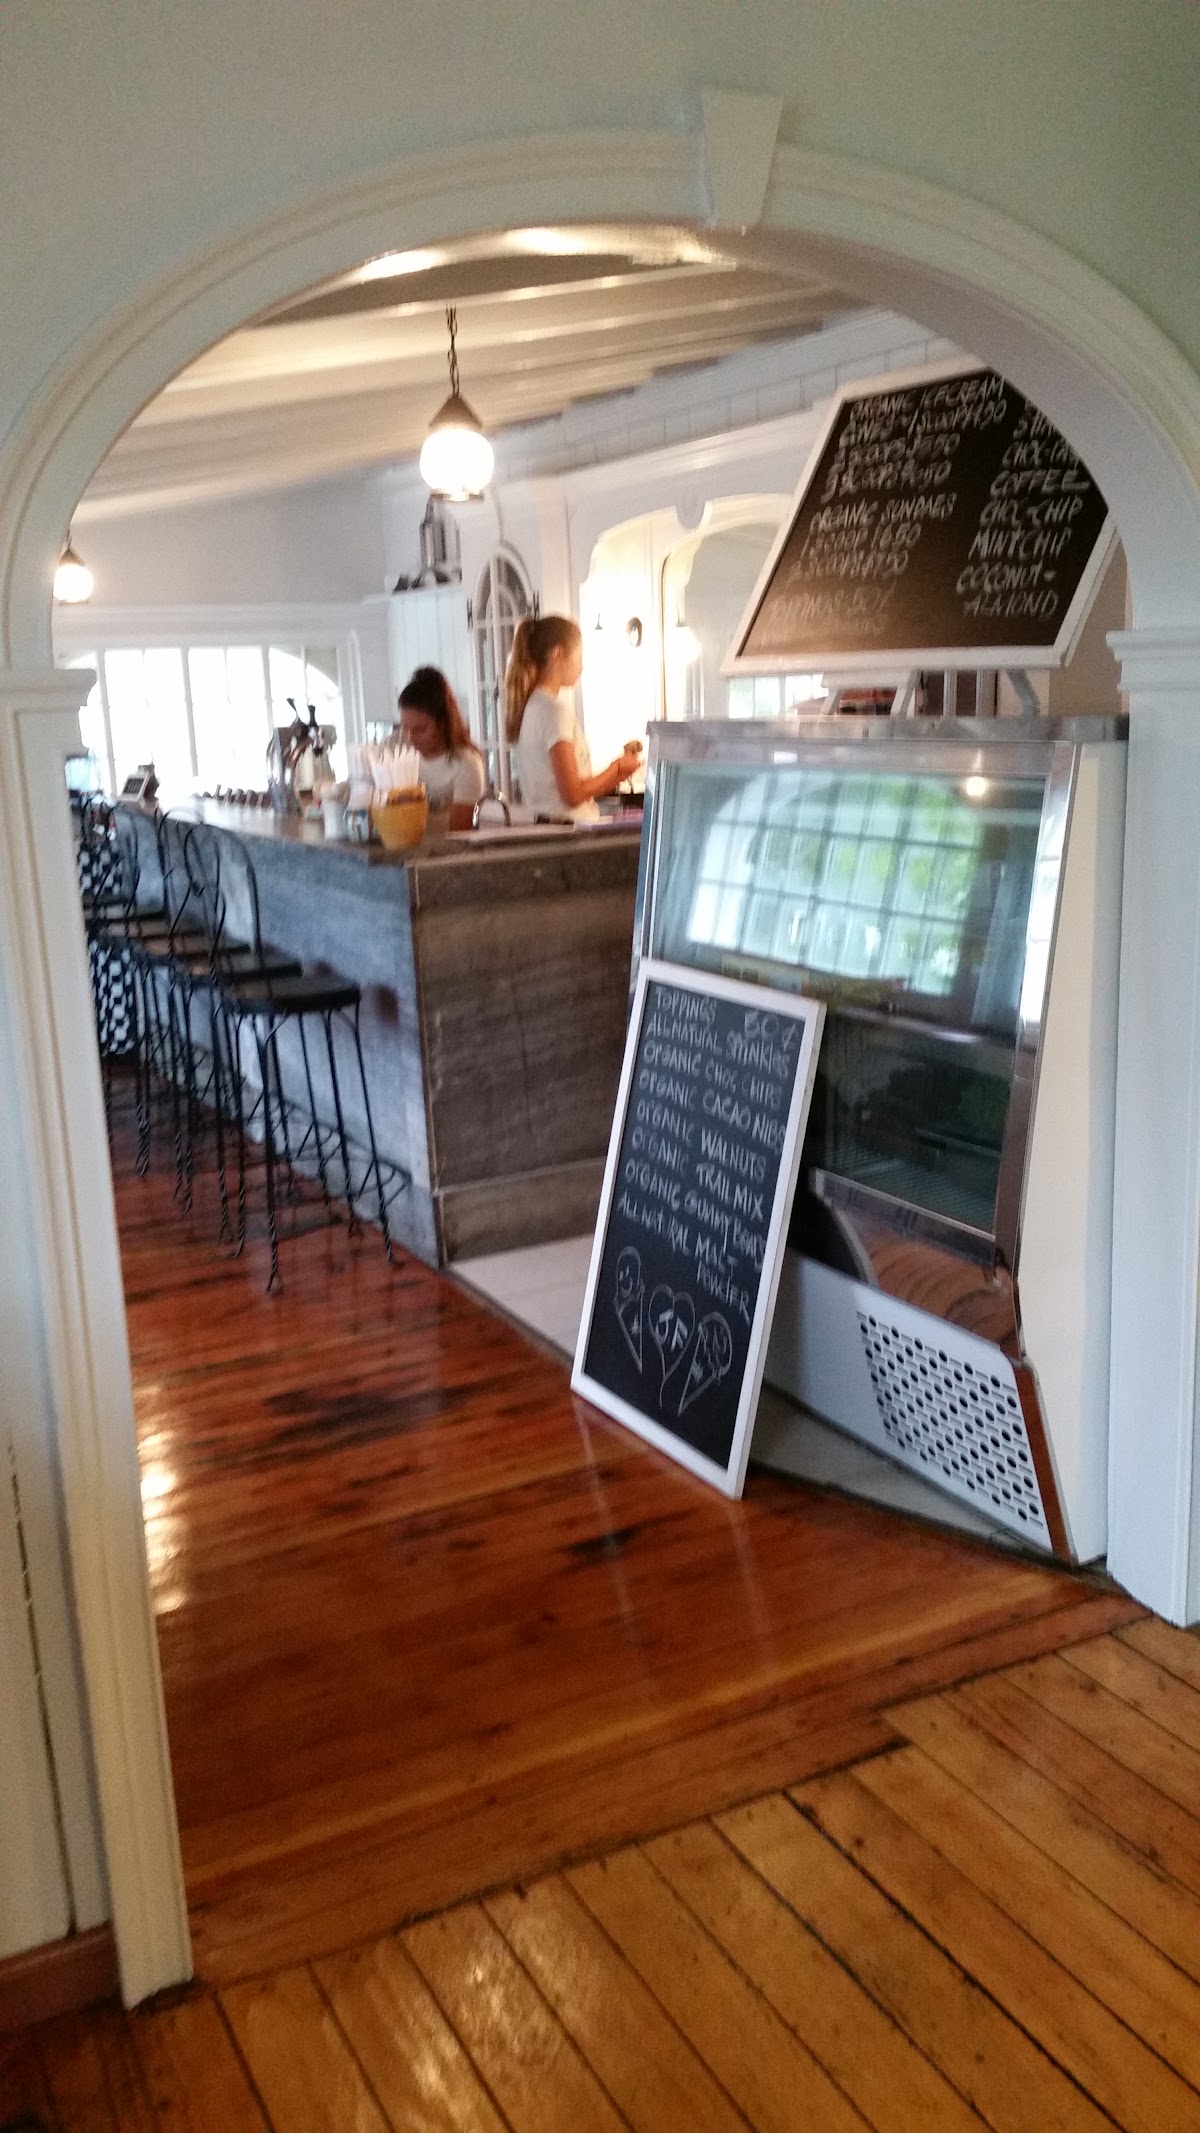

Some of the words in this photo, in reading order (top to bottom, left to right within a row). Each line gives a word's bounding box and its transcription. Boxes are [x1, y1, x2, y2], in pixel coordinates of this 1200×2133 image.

[963, 589, 1060, 622] ALMOND
[702, 1088, 752, 1132] CACAO
[700, 1126, 768, 1183] WALNUTS
[732, 1184, 765, 1223] MIX
